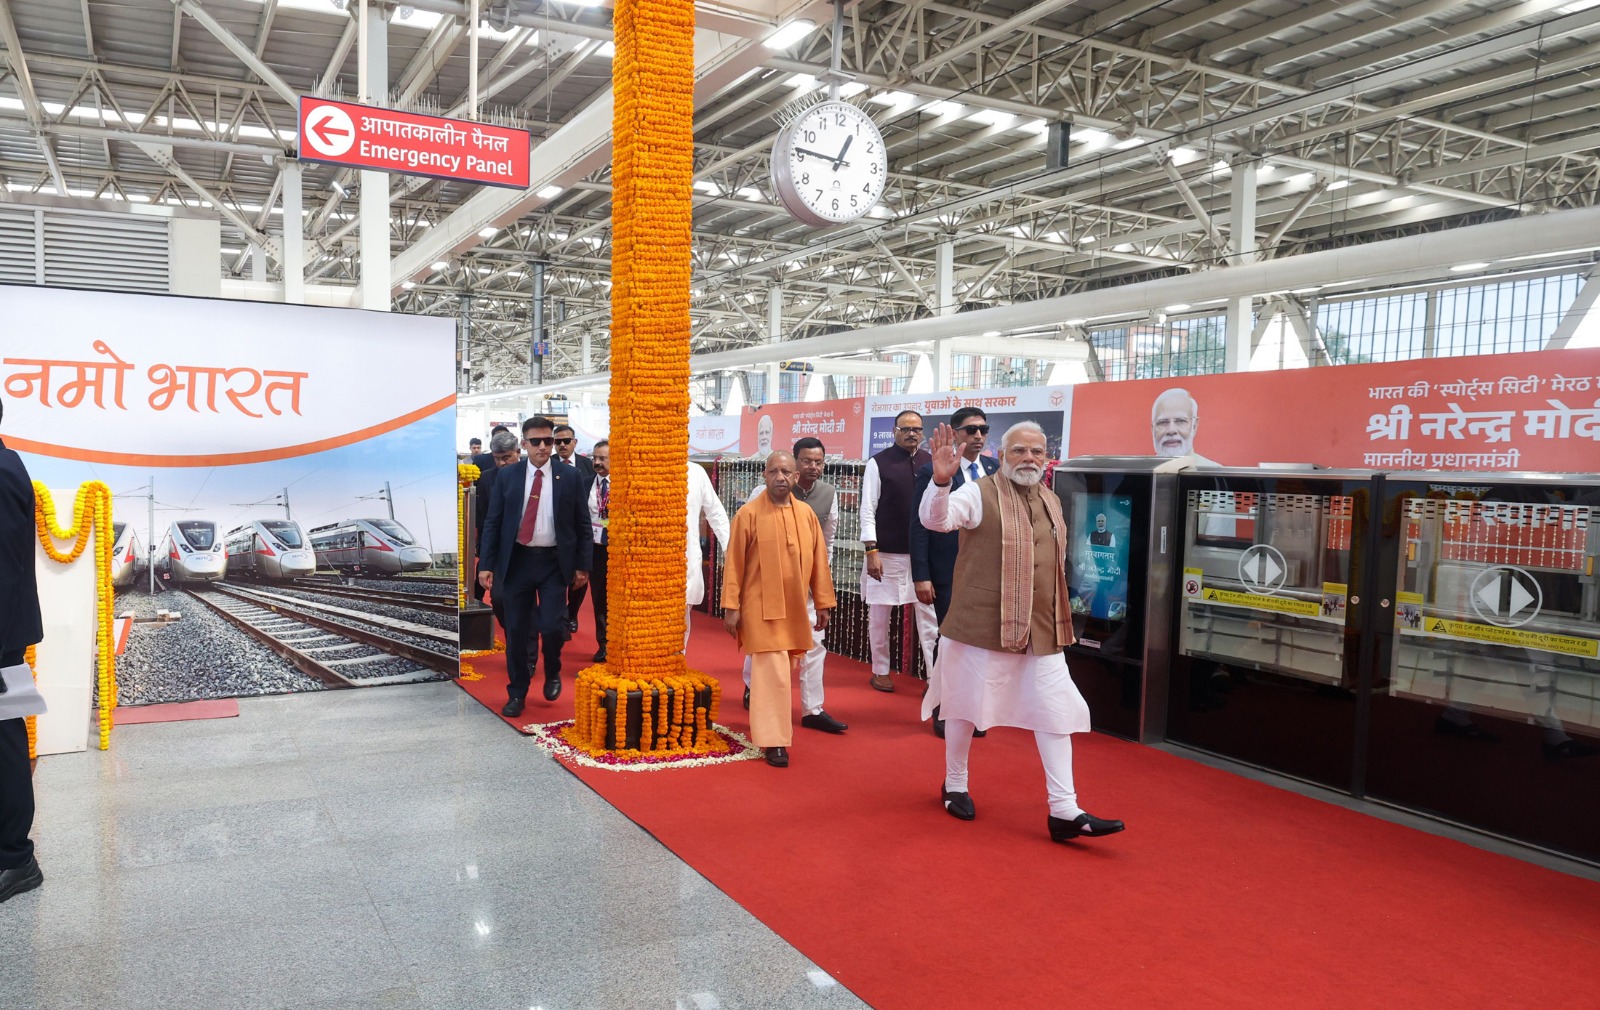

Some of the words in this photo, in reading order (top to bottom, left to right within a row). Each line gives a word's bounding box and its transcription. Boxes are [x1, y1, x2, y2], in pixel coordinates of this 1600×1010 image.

[820, 117, 827, 130] 11
[835, 113, 846, 127] 12
[360, 116, 467, 147] आपातकालीन
[471, 128, 509, 153] पैनल
[804, 130, 816, 143] 10
[856, 124, 860, 136] 1
[866, 141, 874, 154] 2
[359, 140, 461, 173] Emergency
[466, 155, 513, 176] Panel
[870, 162, 878, 175] 3
[801, 172, 810, 185] 8
[862, 182, 870, 194] 4
[815, 189, 823, 201] 7
[850, 194, 858, 207] 5
[831, 198, 839, 211] 6
[3, 339, 135, 411] नमो
[147, 363, 309, 418] भारत
[1368, 386, 1404, 399] भारत
[1407, 381, 1430, 398] की
[1550, 373, 1593, 391] मेरठ
[953, 395, 962, 409] के
[984, 396, 1018, 408] सरकार
[792, 420, 801, 434] श्री
[819, 419, 835, 434] मोदी
[836, 418, 845, 433] जी
[1366, 404, 1413, 441] श्री
[1419, 402, 1516, 443] नरेन्द्र
[873, 431, 878, 439] 9
[1364, 448, 1427, 467] माननीय
[1431, 449, 1521, 468] प्रधानमंत्री
[1560, 645, 1591, 654] PLATFORM
